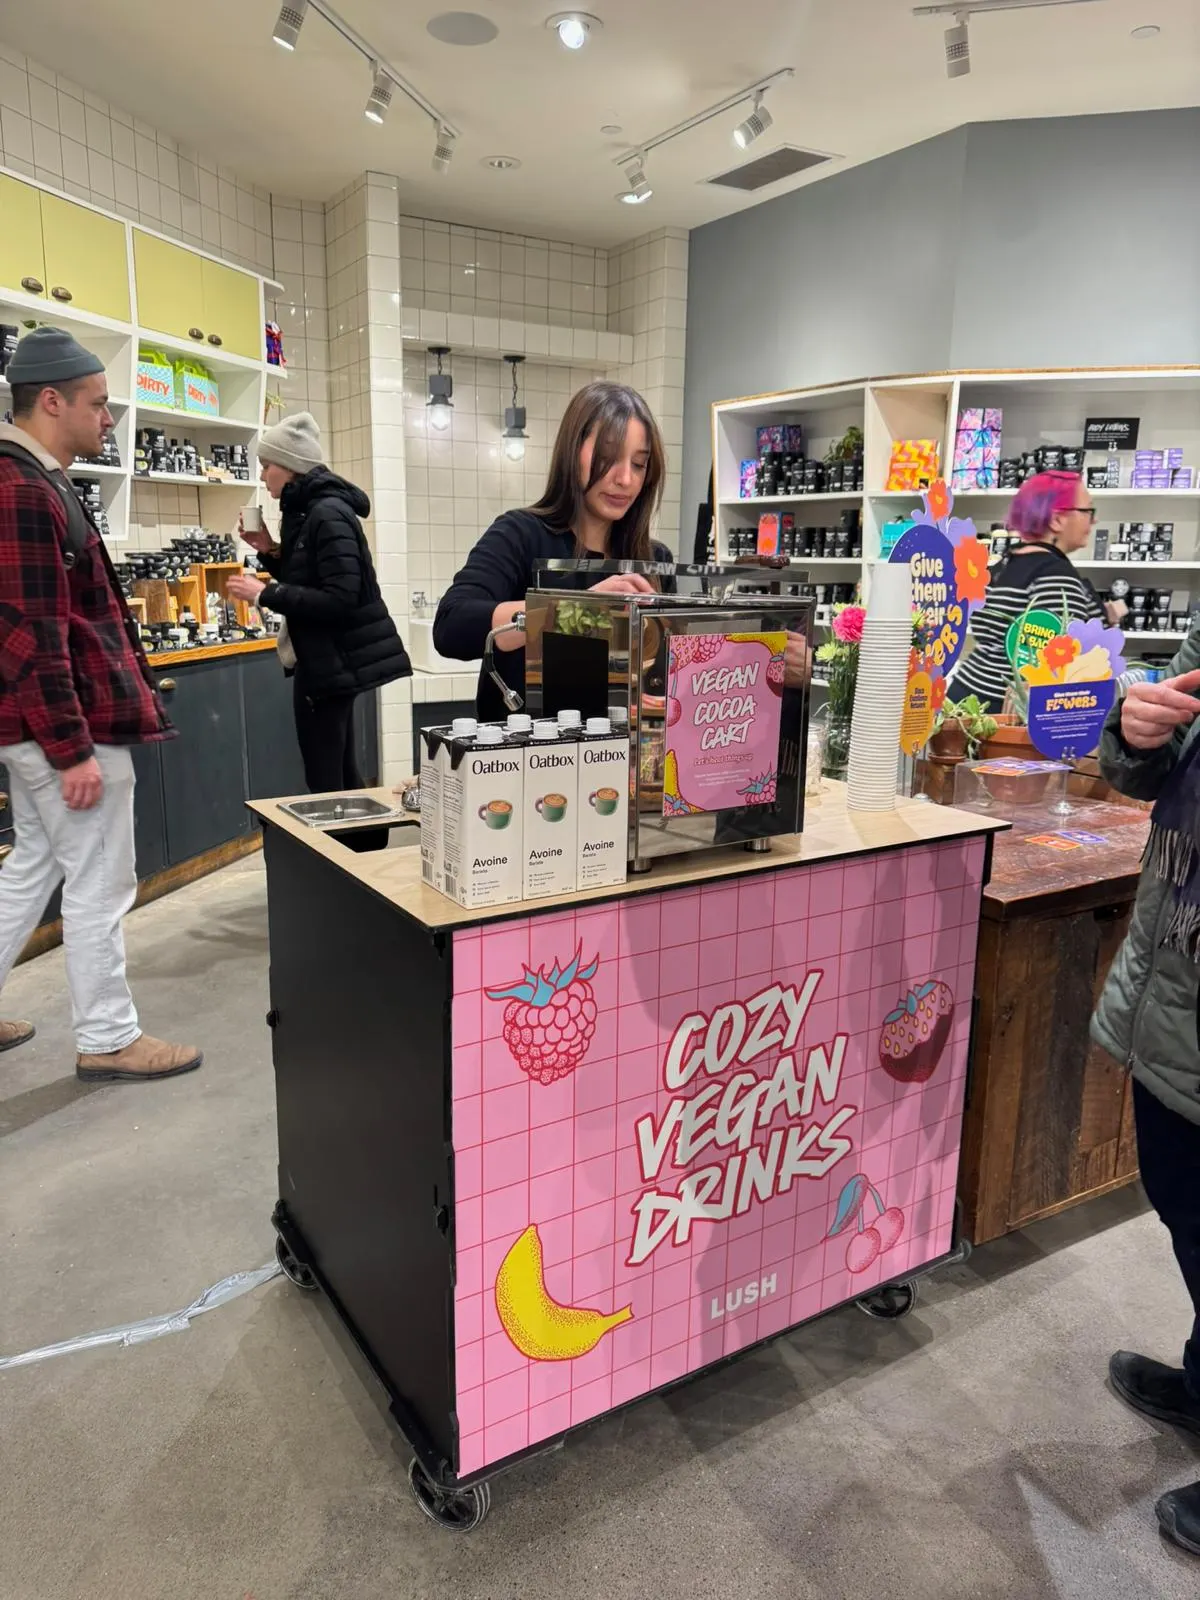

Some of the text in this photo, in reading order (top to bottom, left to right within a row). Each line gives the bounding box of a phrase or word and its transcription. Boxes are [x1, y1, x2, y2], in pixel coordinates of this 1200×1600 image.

[136, 373, 170, 397] DIRTY
[910, 552, 944, 578] Give
[1023, 622, 1056, 640] BRING
[1028, 636, 1049, 649] BAC
[691, 662, 760, 696] VEGAN
[693, 694, 757, 726] COCOA
[1045, 695, 1098, 712] FLOWERS
[700, 718, 756, 751] CART
[472, 759, 520, 775] Oatbox
[529, 754, 575, 770] Oatbox
[583, 749, 626, 765] Oatbox
[529, 848, 563, 860] Avoine
[583, 840, 615, 852] Avoine
[472, 855, 508, 868] Avoine
[665, 969, 824, 1092] COZY
[635, 1033, 849, 1181] VEGAN
[625, 1105, 857, 1266] DRINKS
[710, 1271, 778, 1320] LUSH
